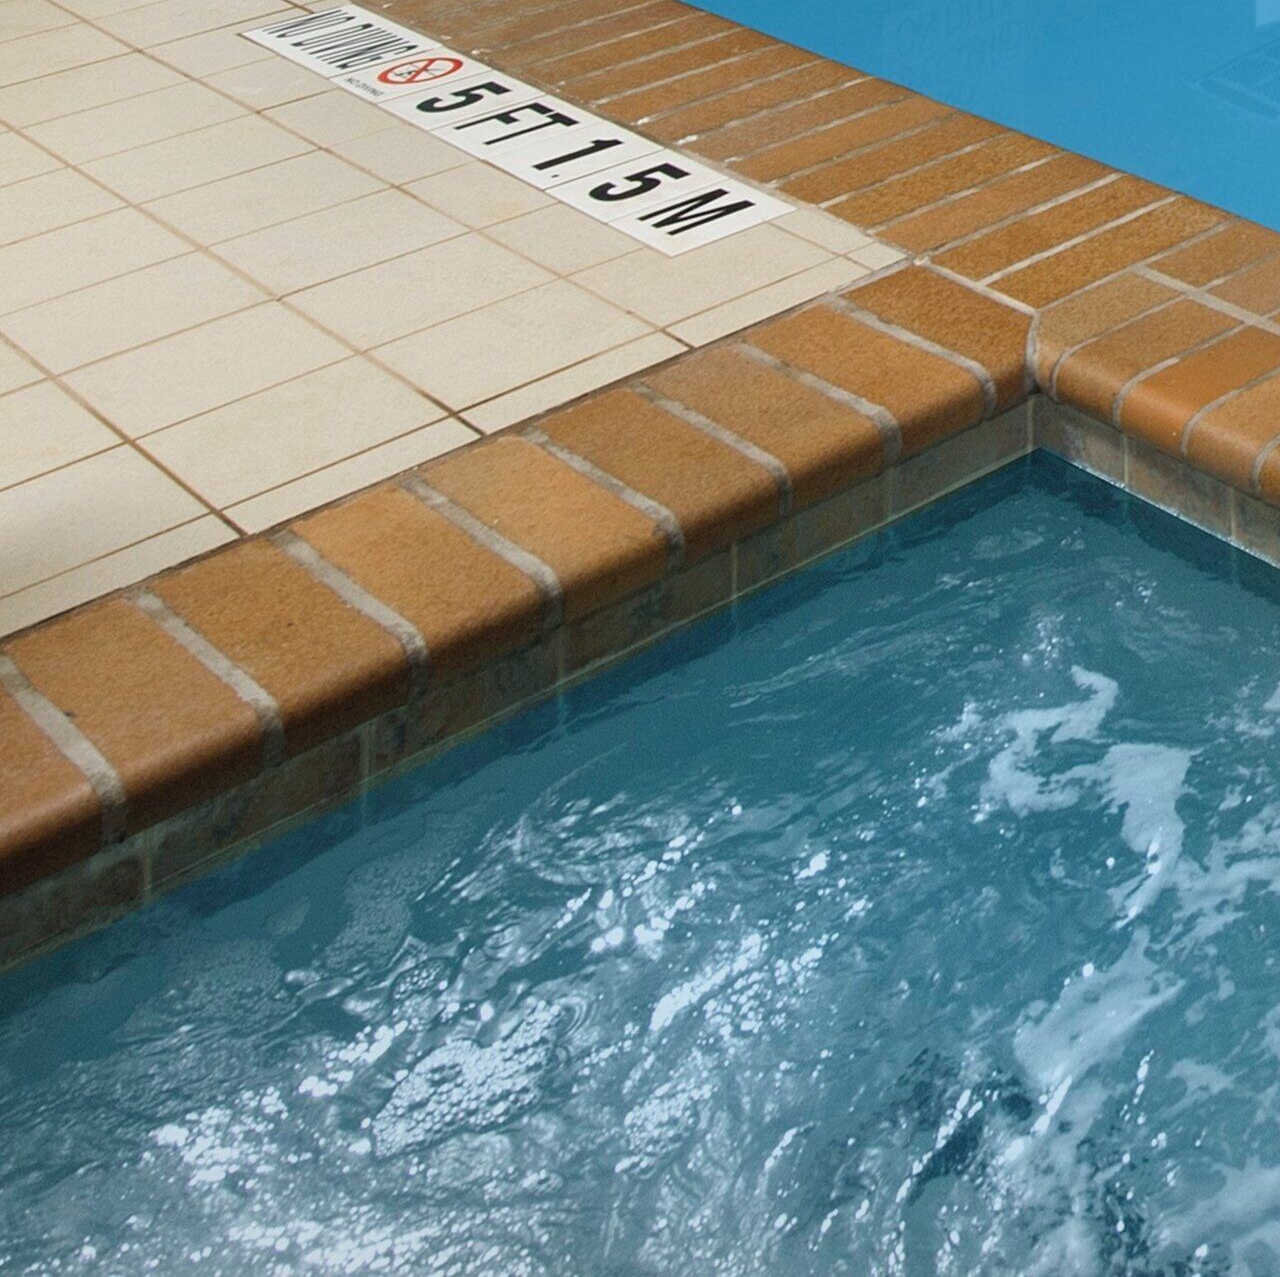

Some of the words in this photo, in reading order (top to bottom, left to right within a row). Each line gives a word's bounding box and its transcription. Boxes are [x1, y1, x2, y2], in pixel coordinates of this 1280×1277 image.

[262, 9, 356, 39] NO
[291, 23, 419, 70] DIVING
[416, 81, 512, 113] 5
[454, 102, 580, 146] FT
[637, 188, 756, 236] M
